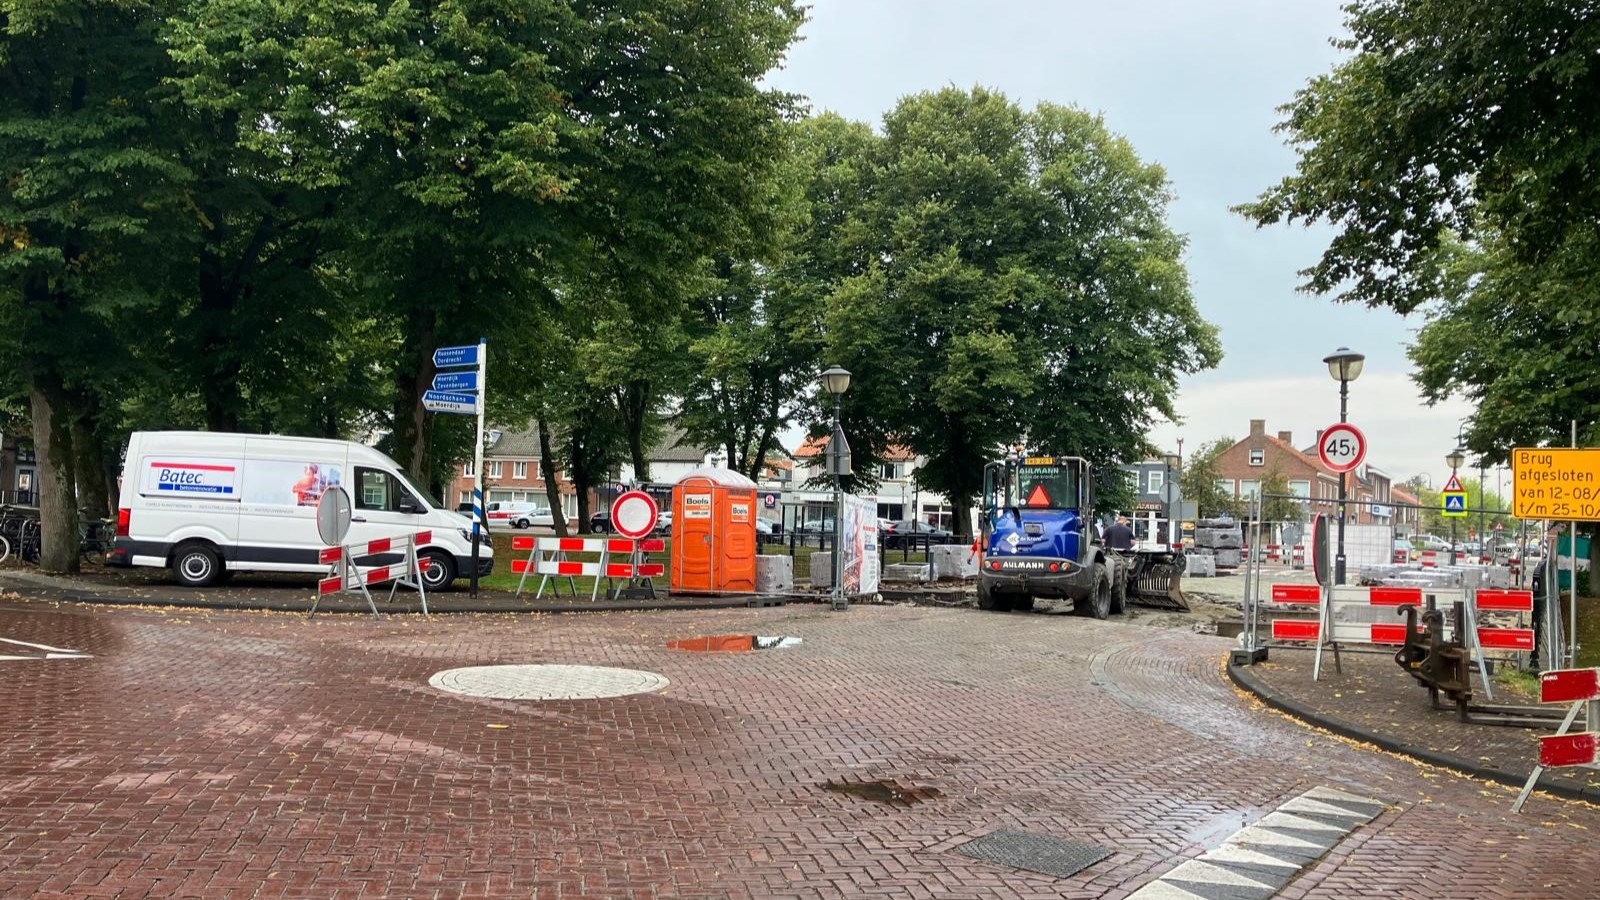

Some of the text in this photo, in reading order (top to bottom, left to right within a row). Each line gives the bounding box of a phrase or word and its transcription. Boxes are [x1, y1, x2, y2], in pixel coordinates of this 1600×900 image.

[428, 394, 466, 402] Noordschans
[435, 402, 460, 410] Moerdijk
[1521, 452, 1552, 468] Brug
[1019, 467, 1059, 475] AHLMANN
[159, 469, 203, 484] Batec
[1520, 469, 1594, 485] afgesloten
[1520, 488, 1545, 499] van
[732, 507, 747, 515] Boels
[1520, 502, 1547, 515] t/m
[1002, 561, 1044, 569] AHLMANN
